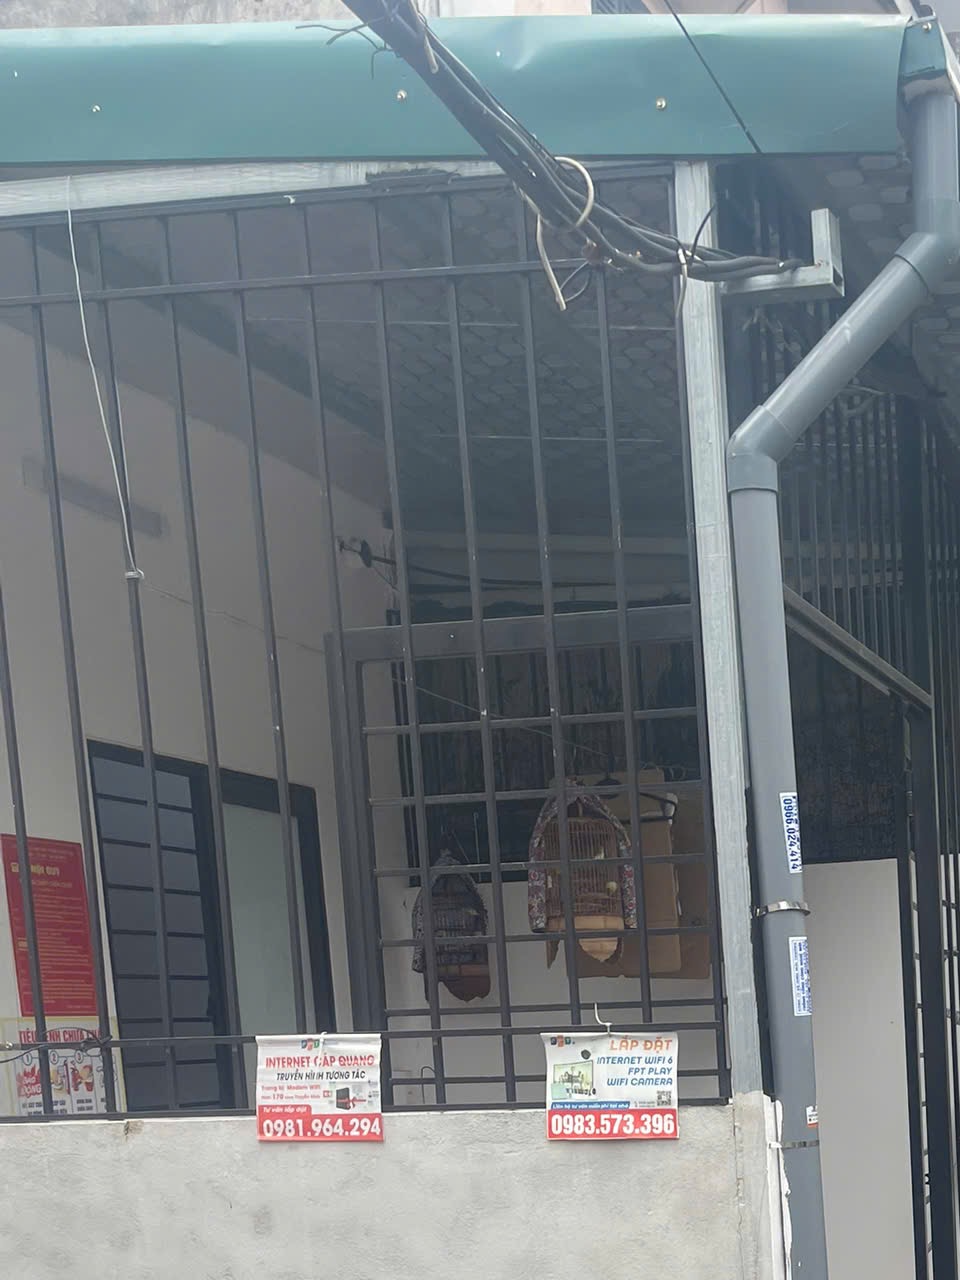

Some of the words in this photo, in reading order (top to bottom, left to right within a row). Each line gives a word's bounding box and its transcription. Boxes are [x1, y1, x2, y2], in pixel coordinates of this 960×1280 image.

[783, 798, 799, 870] 0966.024.414
[609, 1034, 639, 1050] LẮP
[643, 1036, 673, 1053] ĐẶT
[266, 1056, 311, 1068] INTERNET
[338, 1054, 375, 1067] QUANG
[596, 1056, 643, 1064] INTERNET
[668, 1056, 673, 1064] 6
[276, 1068, 304, 1080] TRUYỀN
[326, 1070, 350, 1080] TƯƠNG
[352, 1068, 366, 1079] TÁC
[628, 1067, 648, 1075] FPT
[648, 1067, 673, 1075] PLAY
[631, 1078, 673, 1086] CAMERA
[262, 1118, 381, 1137] 0981.964.294
[552, 1114, 675, 1135] 0983.573.396
